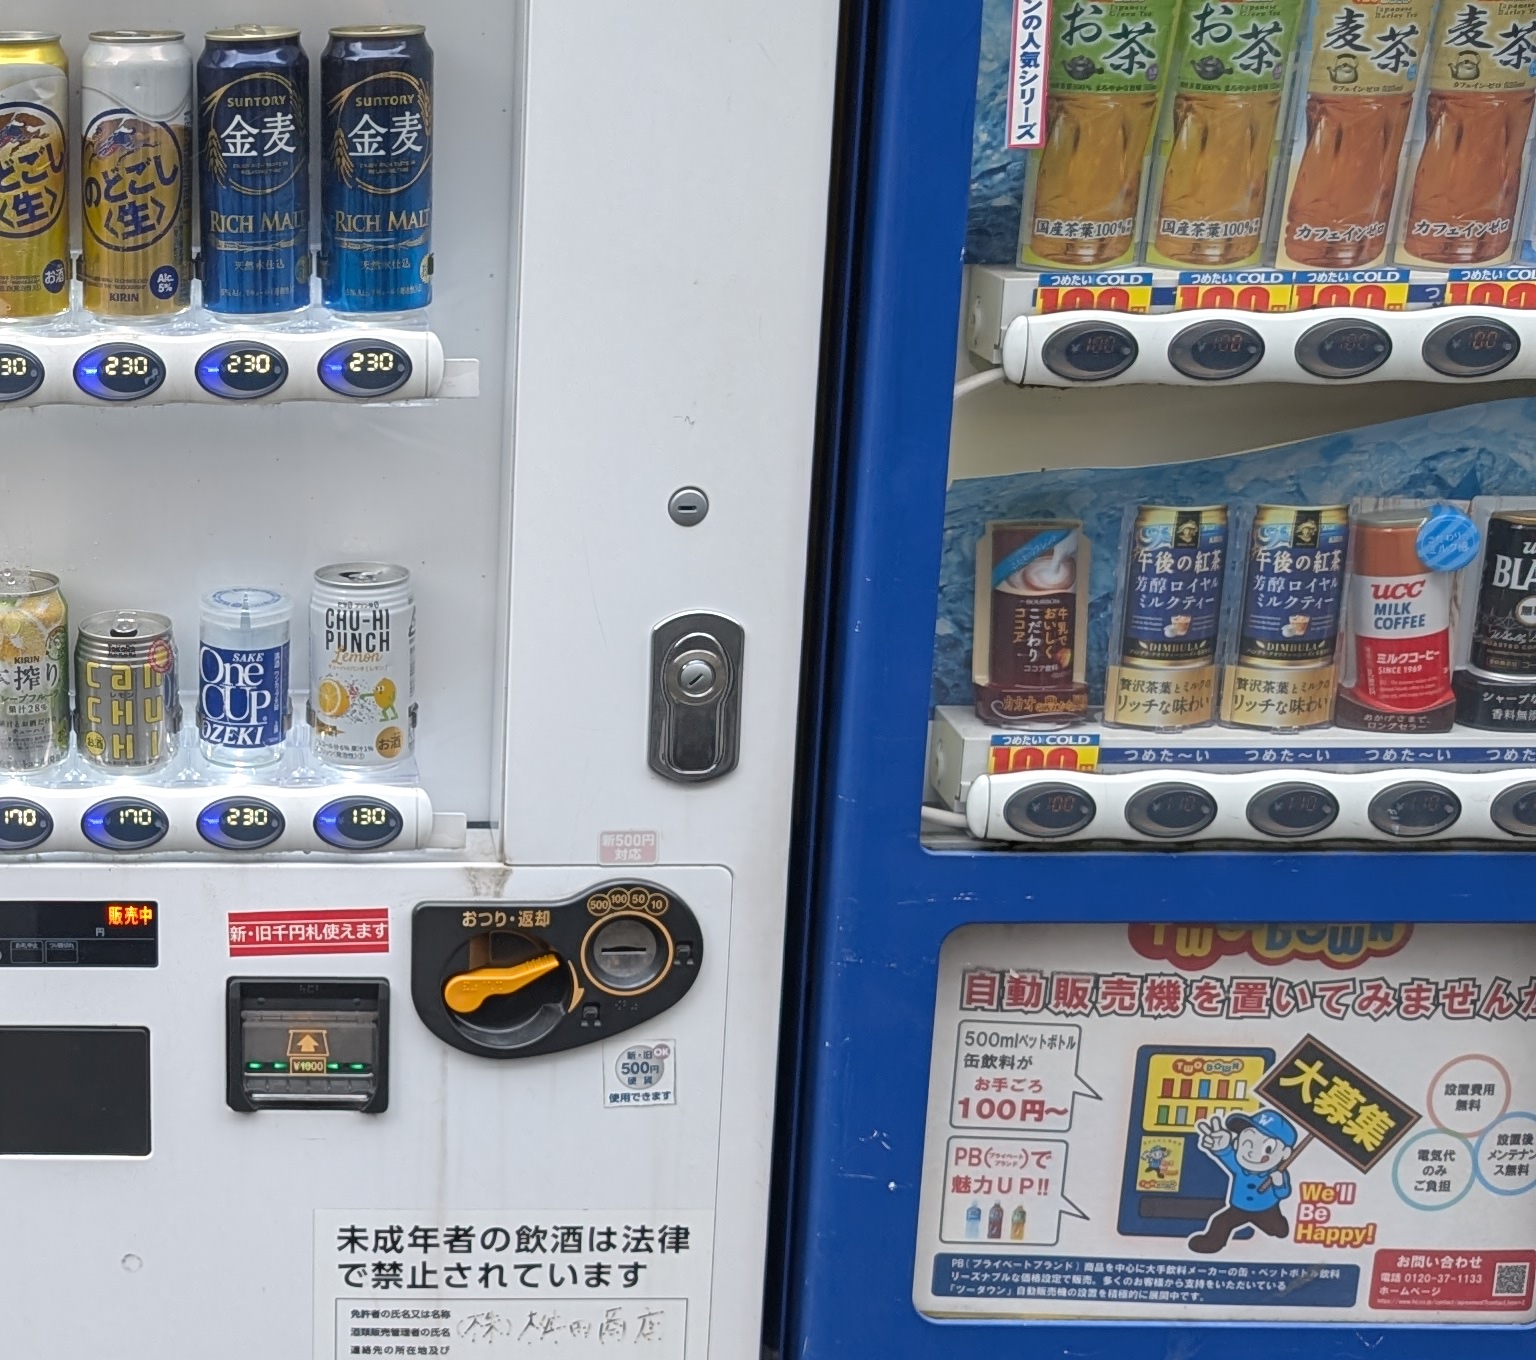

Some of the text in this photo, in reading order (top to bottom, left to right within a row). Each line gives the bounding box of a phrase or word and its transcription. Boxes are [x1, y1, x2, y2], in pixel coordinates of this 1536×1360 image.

[226, 94, 287, 108] SUNTORY
[354, 94, 416, 108] SUNTORY
[220, 112, 297, 158] 金麦
[347, 112, 424, 158] 金麦
[84, 154, 180, 208] のどごし
[210, 209, 255, 234] RICH
[334, 207, 431, 233] RICH MALT
[1097, 273, 1143, 286] COLD
[1236, 272, 1284, 285] COLD
[1352, 270, 1400, 284] COLD
[108, 292, 140, 303] KIRIN
[105, 356, 148, 376] 230
[351, 352, 394, 372] 230
[1137, 549, 1222, 574] 午後の紅茶
[1255, 548, 1343, 574] 午後の紅茶
[1139, 596, 1215, 610] ミルクティー
[1256, 596, 1335, 610] ミルクティー
[1373, 601, 1412, 616] MILK
[324, 607, 391, 632] CHU-HI
[1373, 613, 1427, 631] COFFEE
[324, 630, 391, 654] PUNCH
[200, 646, 265, 688] One
[232, 652, 265, 663] SAKE
[1376, 649, 1441, 665] ミルクコーヒー
[202, 683, 272, 725] CUP
[3, 807, 37, 827] 170
[225, 806, 268, 826] 230
[352, 805, 386, 825] 130
[590, 893, 663, 911] 500 100 50 10
[107, 904, 154, 926] 販売中
[462, 909, 552, 930] おつり・返却
[229, 921, 389, 943] 新・旧千円札使えます
[620, 1061, 661, 1077] 500円
[963, 1053, 1033, 1070] 缶飲料が
[974, 1077, 1043, 1093] お手ごろ
[1444, 1084, 1495, 1096] 設置費用
[608, 1090, 673, 1105] 使用できます
[1279, 1055, 1396, 1152] 大募集
[1455, 1099, 1481, 1112] 無料
[1418, 1149, 1456, 1161] 電気代
[1301, 1183, 1355, 1204] We'll
[1299, 1202, 1330, 1222] Be
[337, 1225, 691, 1254] 未成年者の飲酒は法律
[1298, 1224, 1375, 1246] Happy!
[1396, 1255, 1483, 1269] お問い合わせ
[337, 1261, 647, 1290] で禁止されています
[1404, 1273, 1483, 1284] 0120-37-1133
